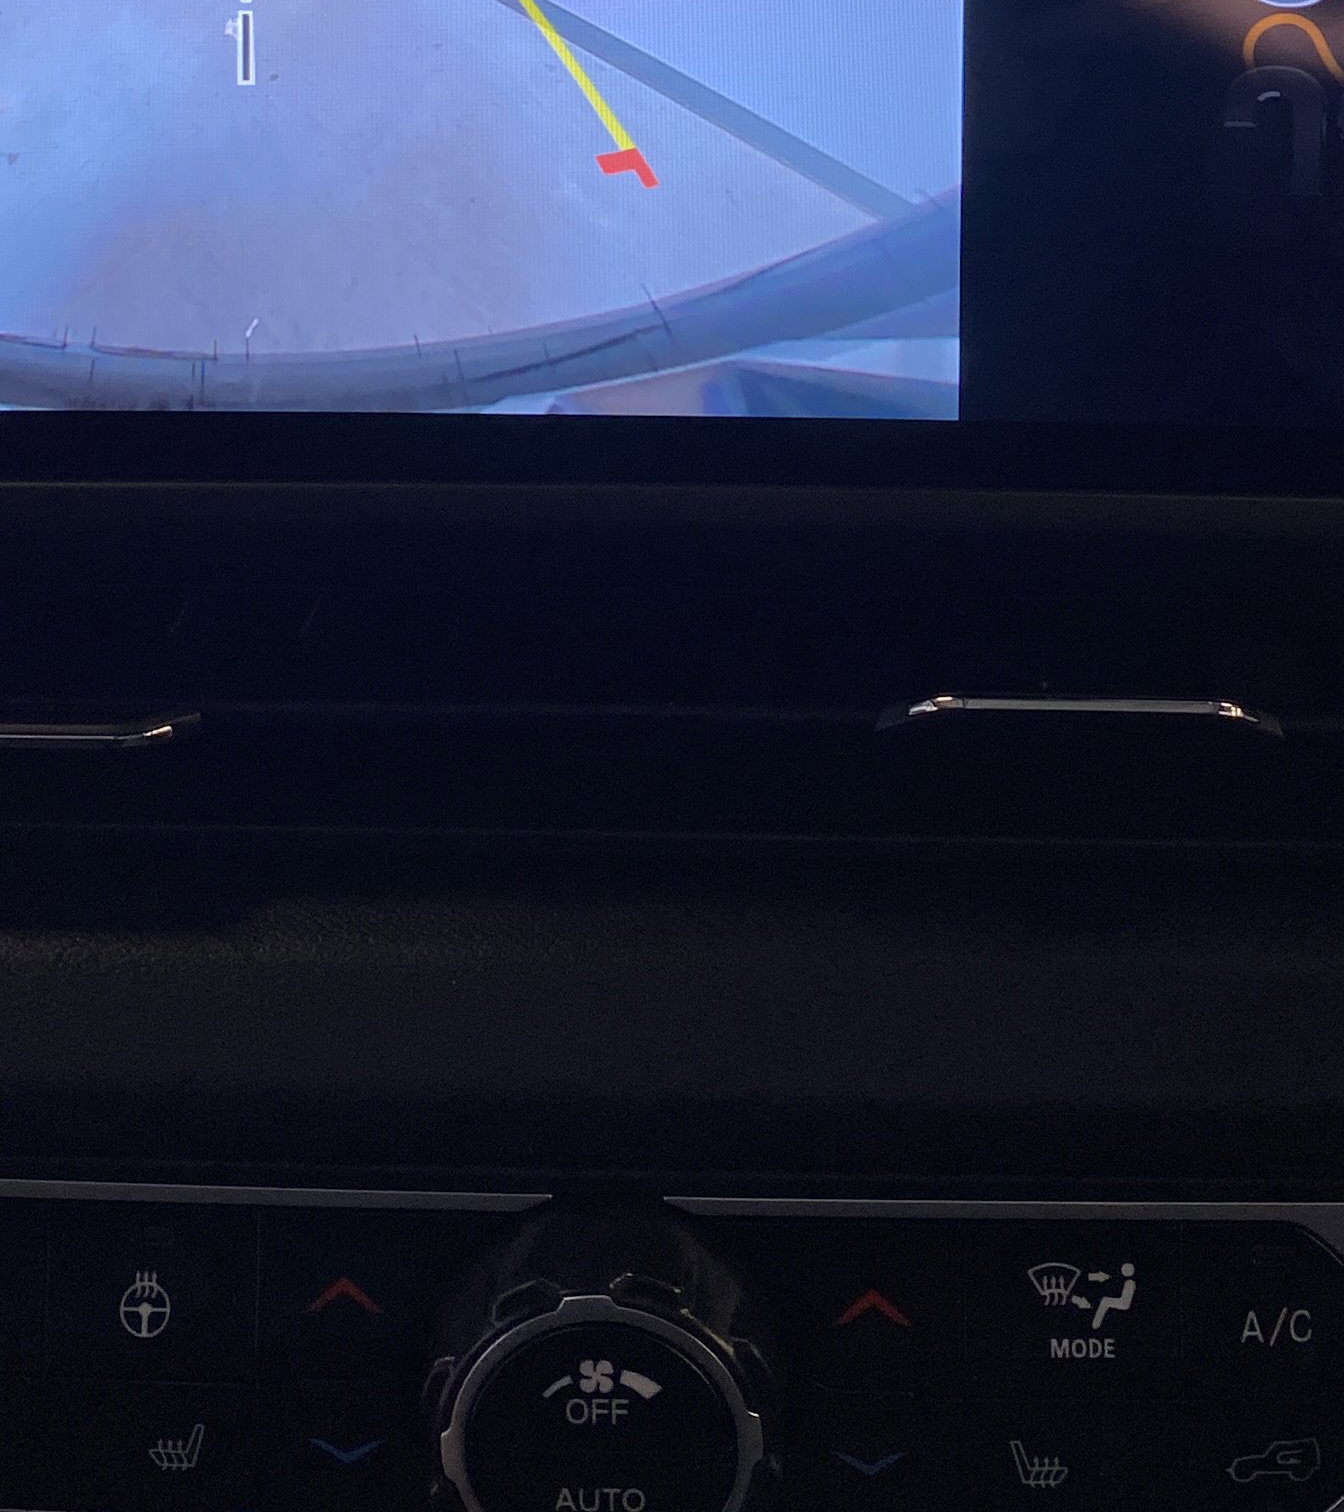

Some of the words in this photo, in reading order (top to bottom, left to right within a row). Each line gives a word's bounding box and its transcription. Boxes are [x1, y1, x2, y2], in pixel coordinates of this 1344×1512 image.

[1240, 1307, 1313, 1346] A/C
[1051, 1338, 1116, 1360] MODE
[565, 1399, 631, 1426] OFF
[557, 1488, 646, 1512] AUTO
